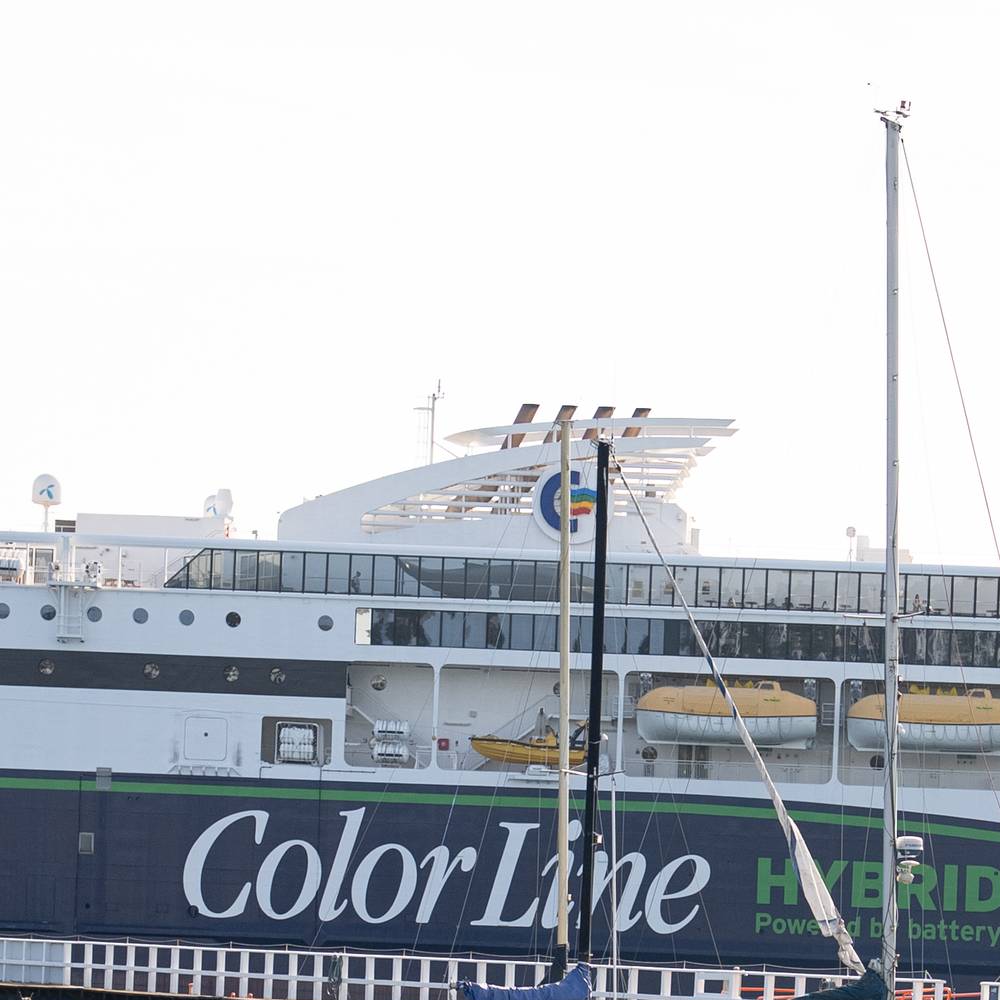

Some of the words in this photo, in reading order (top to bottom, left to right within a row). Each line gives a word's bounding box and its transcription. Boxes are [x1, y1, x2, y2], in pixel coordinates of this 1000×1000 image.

[182, 806, 478, 924] Color
[470, 819, 711, 934] Line
[755, 912, 860, 937] Powed
